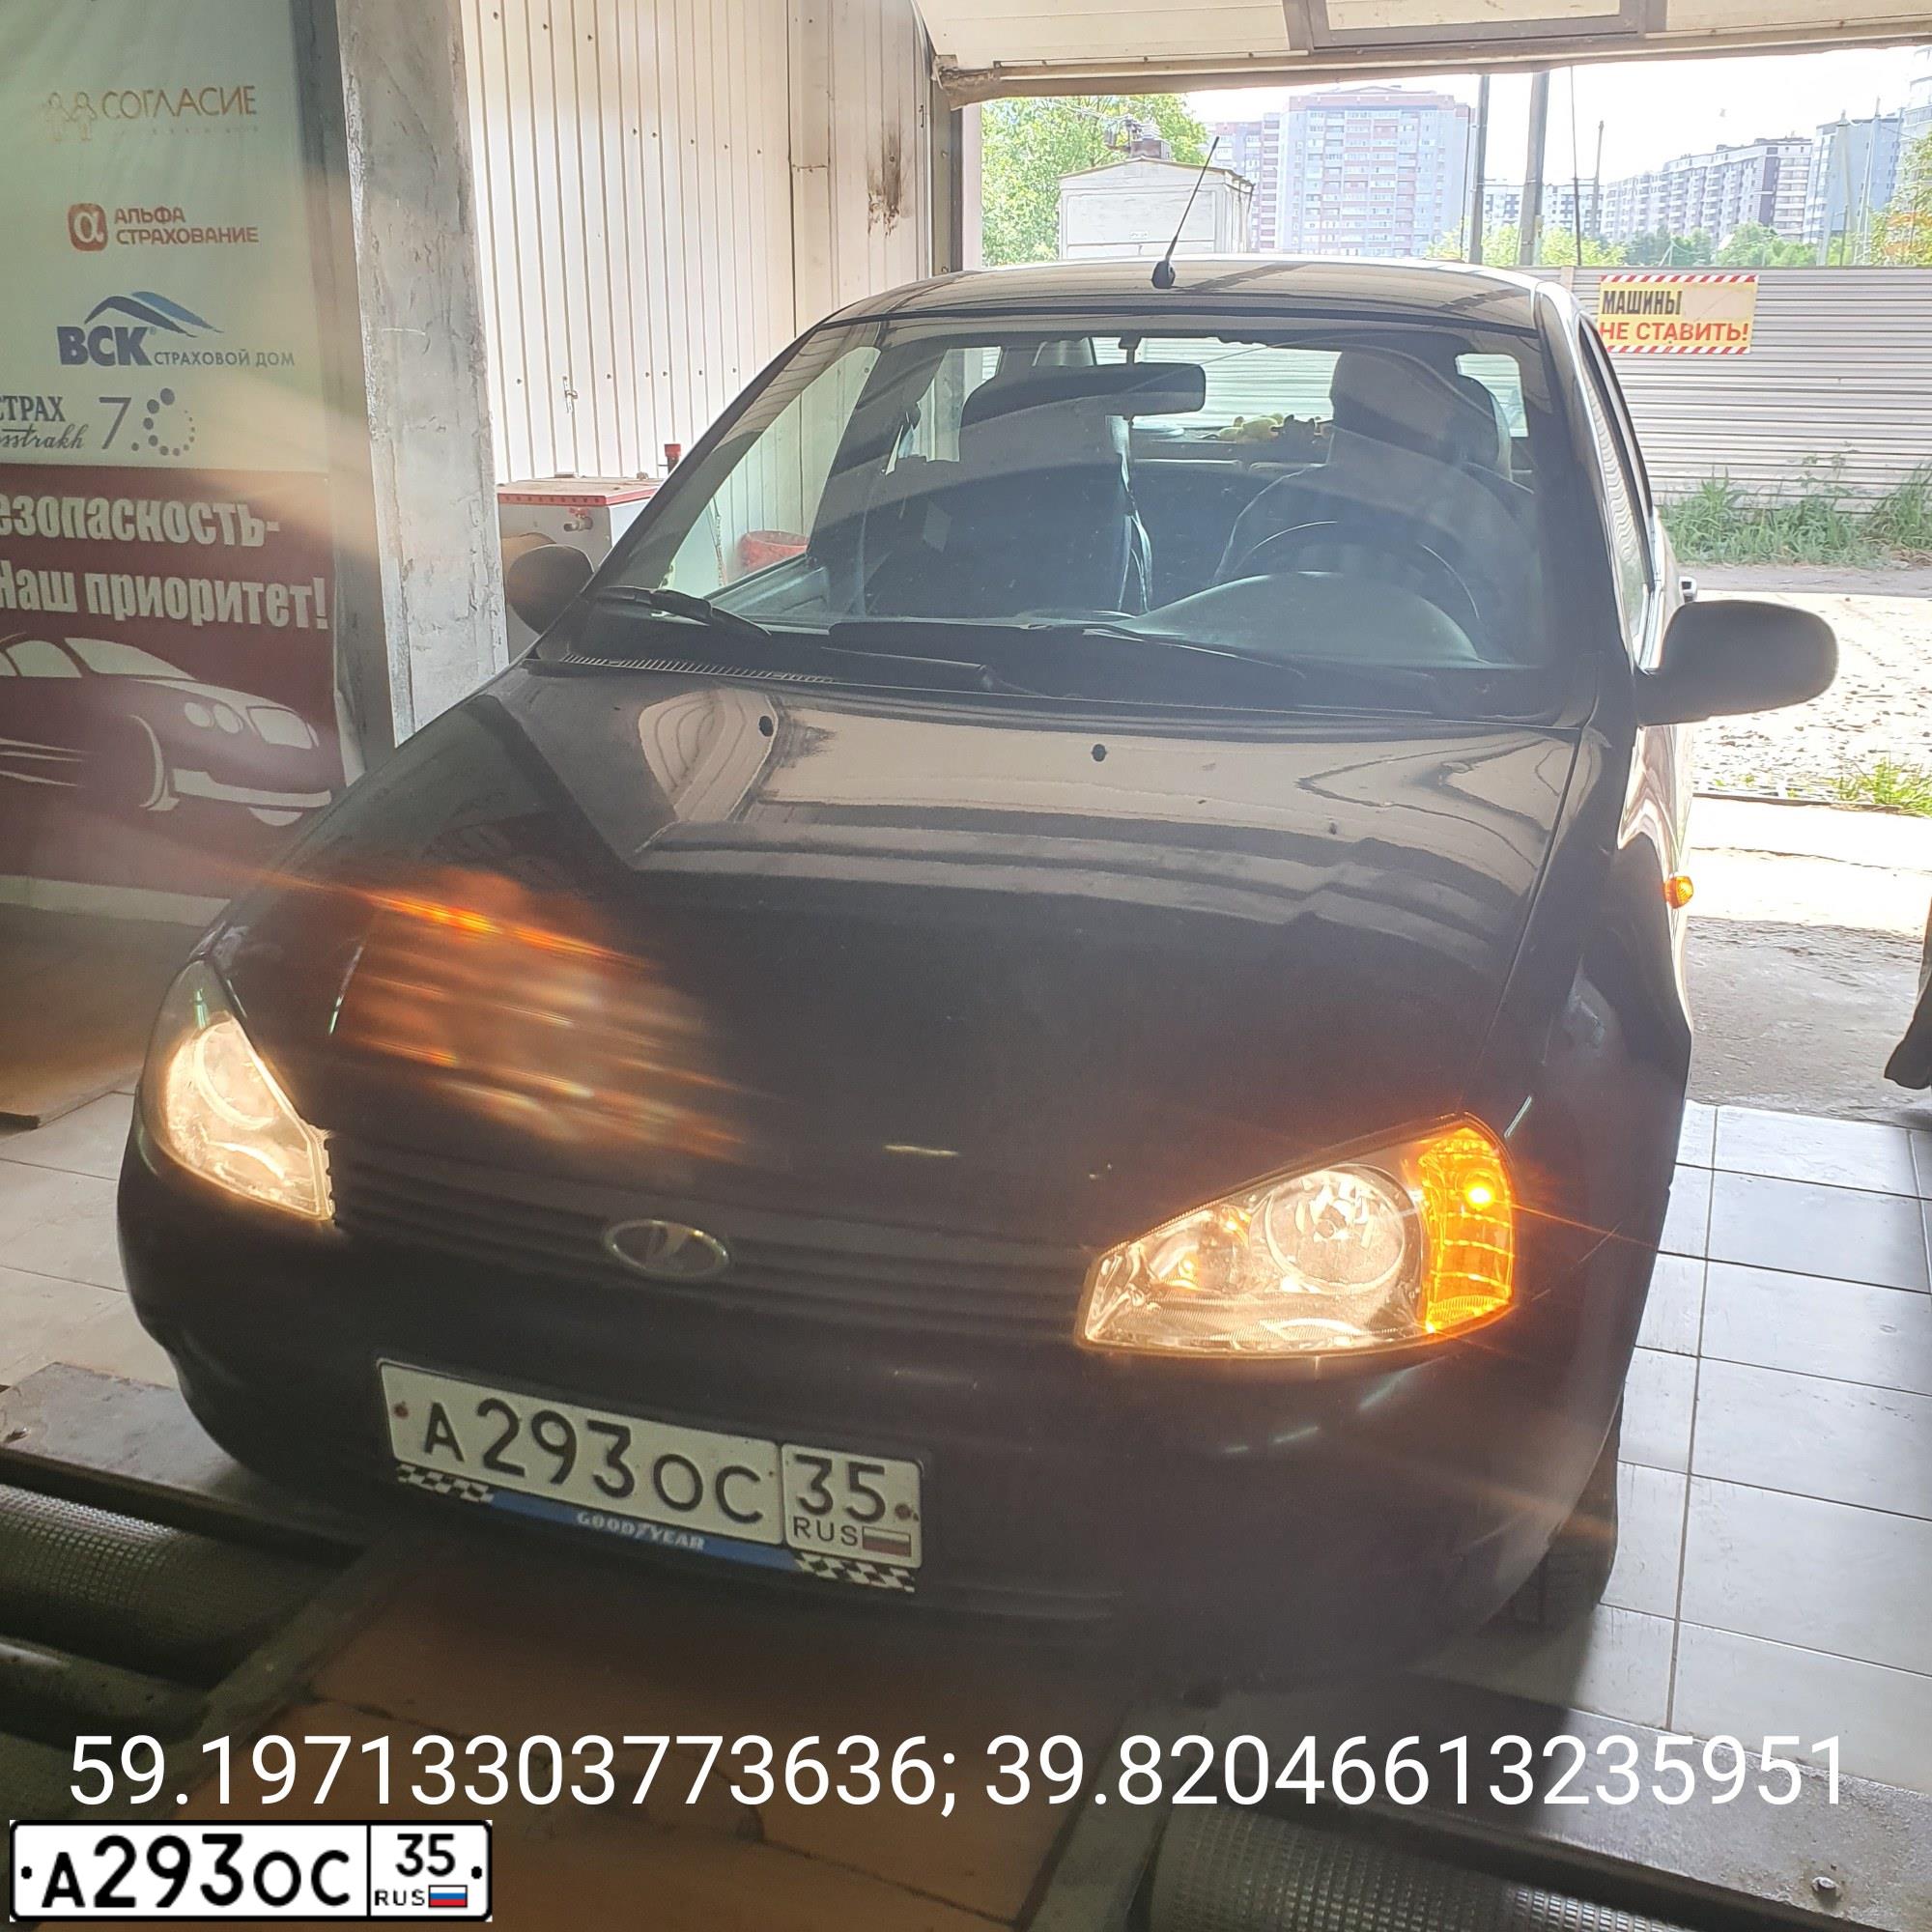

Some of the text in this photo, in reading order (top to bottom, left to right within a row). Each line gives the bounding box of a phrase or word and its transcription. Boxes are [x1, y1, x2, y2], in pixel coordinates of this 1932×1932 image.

[101, 86, 257, 119] СОГЛАСИЕ
[114, 206, 185, 224] АЛЬФА
[116, 227, 259, 245] СТРАХОВАНИЕ
[1602, 291, 1683, 315] МАШИНЫ
[1600, 322, 1749, 341] НЕ СТАВИТЬ!
[154, 349, 250, 366] СТРАХОВОЙ
[255, 351, 296, 368] ДОМ
[0, 395, 66, 422] ТРАХ
[0, 559, 328, 630] Наш приоритет!
[423, 1397, 887, 1523] А293ОС 35
[577, 1511, 705, 1551] GOODYEAR
[792, 1516, 859, 1547] RUS
